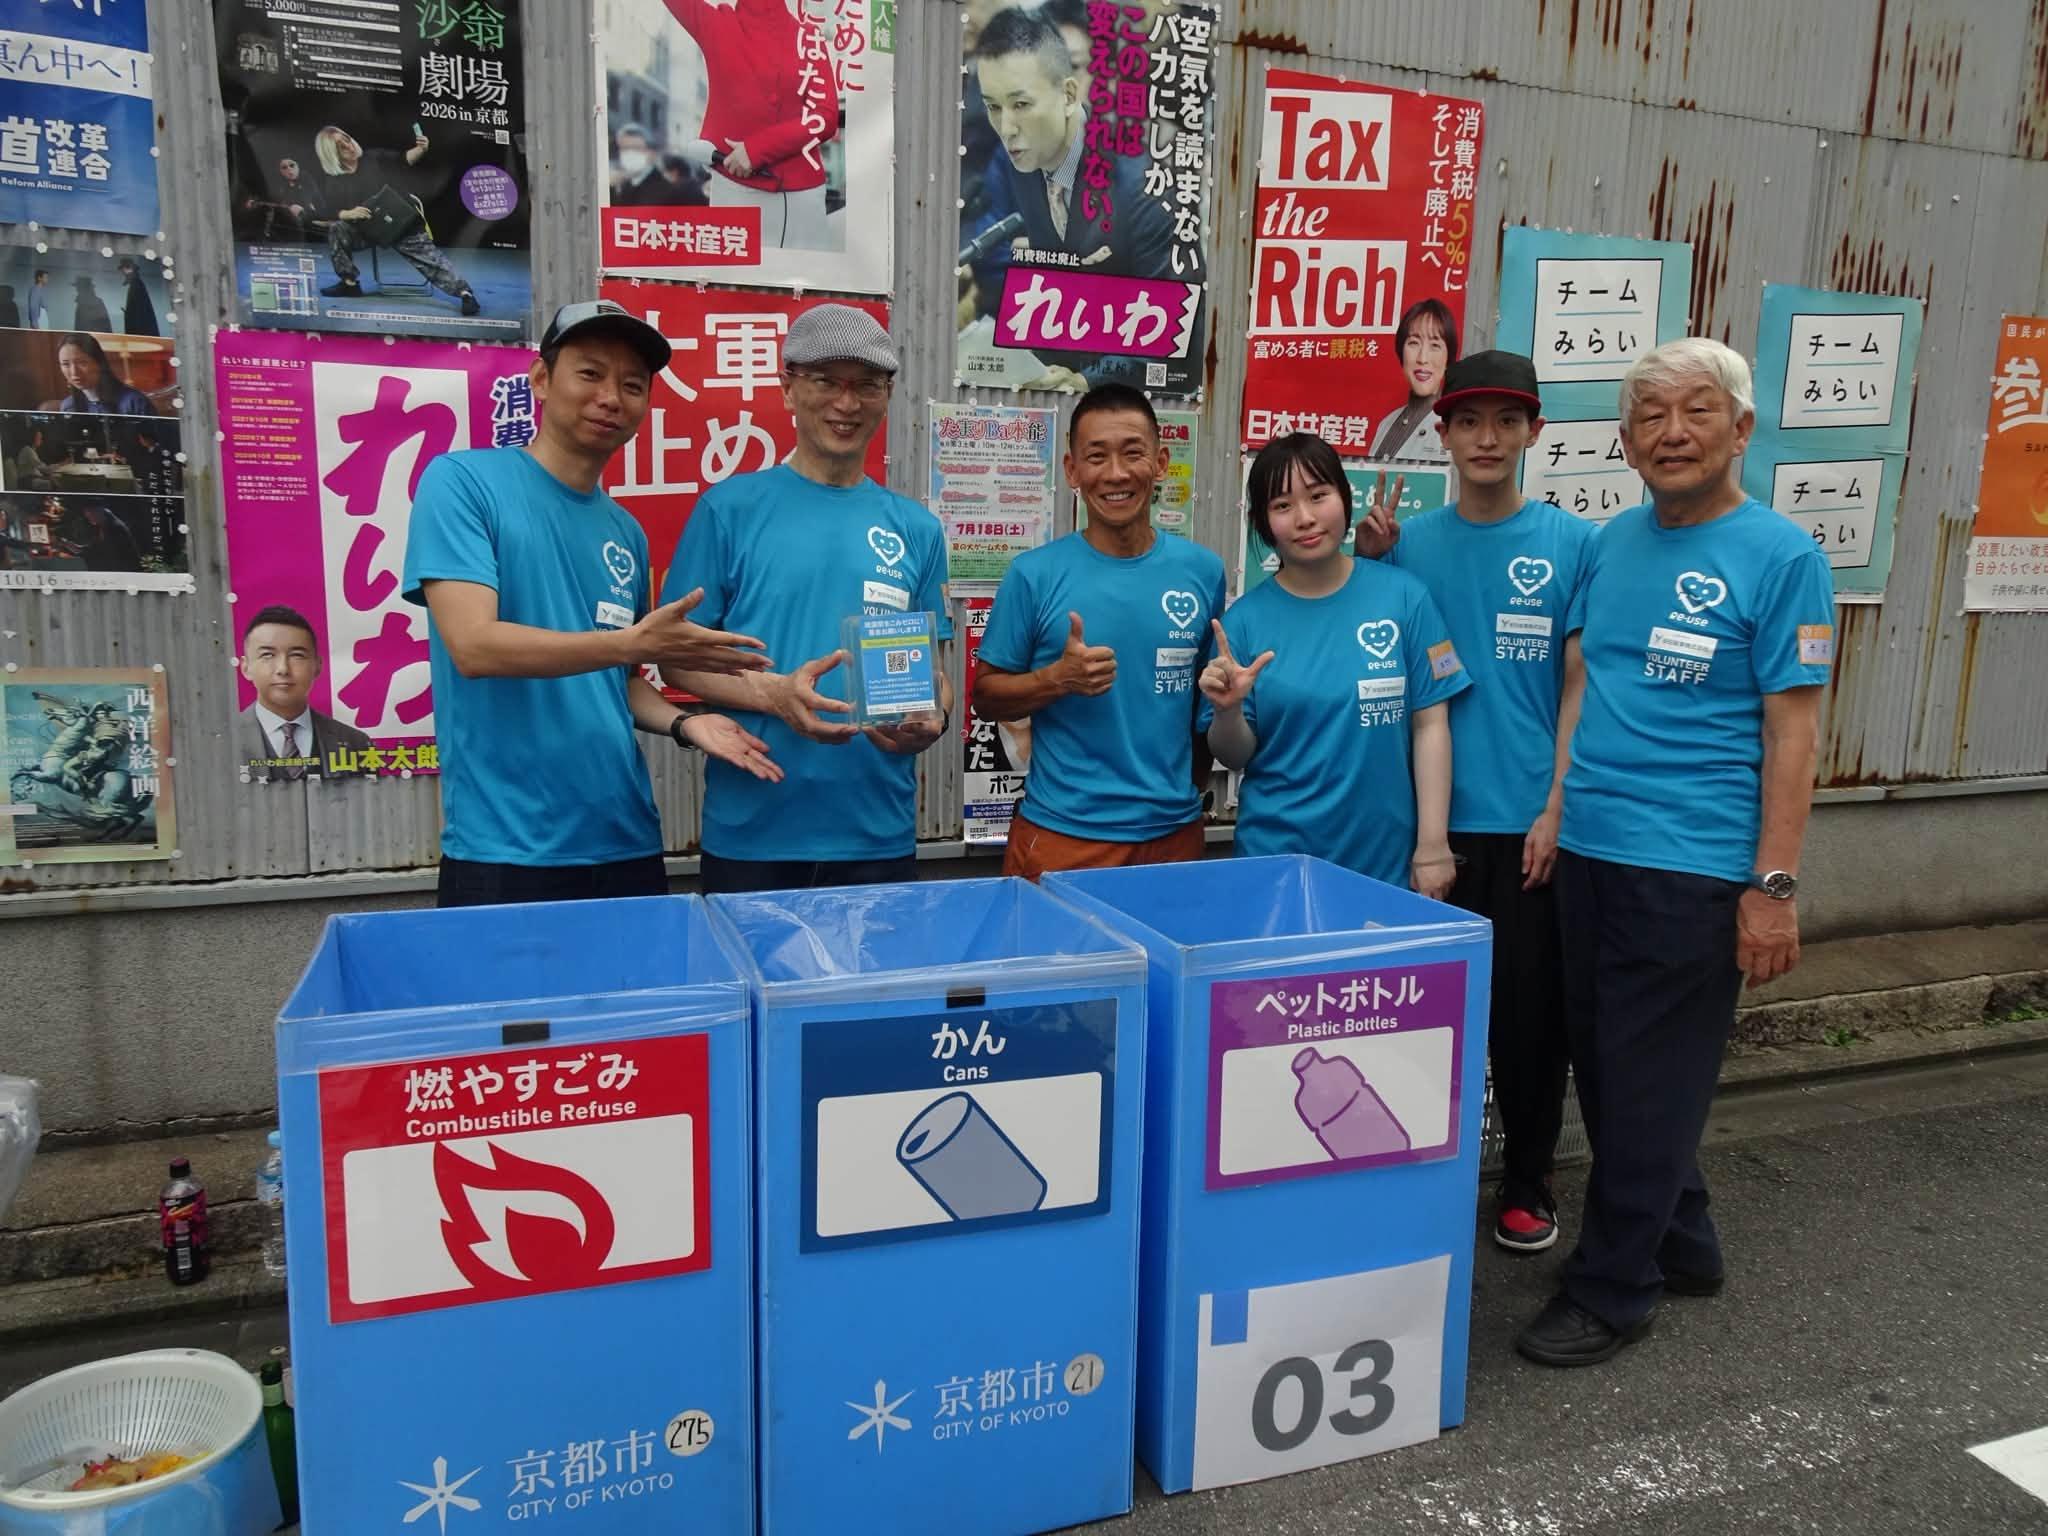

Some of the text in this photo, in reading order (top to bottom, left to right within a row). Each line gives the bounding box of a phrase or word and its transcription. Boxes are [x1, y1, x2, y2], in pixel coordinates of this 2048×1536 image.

[873, 5, 893, 49] 人権
[418, 51, 510, 106] 劇場
[1116, 5, 1149, 157] この国は
[421, 101, 509, 126] 2026 in 京都
[1081, 1, 1119, 234] 変えられない。
[1144, 13, 1181, 214] バカにしか、
[44, 119, 109, 151] 改革
[1172, 16, 1212, 275] 空気を読まない
[1270, 96, 1383, 182] Tax
[48, 148, 111, 181] 連合
[1, 176, 73, 192] Reform Alliance
[1420, 103, 1453, 268] そして廃止へ
[1262, 191, 1329, 238] the
[614, 217, 749, 257] 日本共産党
[1012, 247, 1081, 267] 消費税は廃止
[1255, 246, 1399, 329] Rich
[1557, 278, 1638, 304] チーム
[1007, 273, 1168, 347] れいわ
[1254, 338, 1379, 360] 富める者に課税を
[1554, 328, 1637, 355] みらい
[1808, 332, 1880, 357] チーム
[1803, 378, 1877, 402] みらい
[1157, 424, 1190, 441] 広場
[1247, 409, 1369, 448] 日本共産党
[608, 408, 798, 498] 止め
[1547, 438, 1625, 466] チーム
[1545, 487, 1621, 513] みらい
[1792, 477, 1863, 503] チーム
[956, 523, 1025, 536] 7月18日(土)
[1495, 635, 1549, 649] VOLUNTEER
[1495, 646, 1548, 662] STAFF
[1644, 662, 1709, 685] STAFF
[1646, 652, 1711, 673] VOLUNTEER
[1360, 709, 1403, 727] STAFF
[127, 687, 161, 798] 西洋絵画
[968, 704, 996, 770] なた
[329, 744, 439, 773] 山本太郎
[1256, 975, 1425, 1018] ペットボトル
[931, 1020, 1007, 1060] かん
[1287, 1015, 1398, 1039] Plastic Bottles
[404, 1052, 639, 1113] 燃やすごみ
[943, 1064, 989, 1082] Cans
[406, 1098, 637, 1139] Combustible Refuse
[933, 1360, 1058, 1420] 京都市
[1071, 1360, 1095, 1391] 21
[1251, 1339, 1396, 1453] 03
[669, 1416, 710, 1449] 275
[933, 1400, 1070, 1441] CITY OF KYOTO
[505, 1429, 657, 1499] 京都市
[507, 1472, 675, 1521] CITY OF KYOTO
